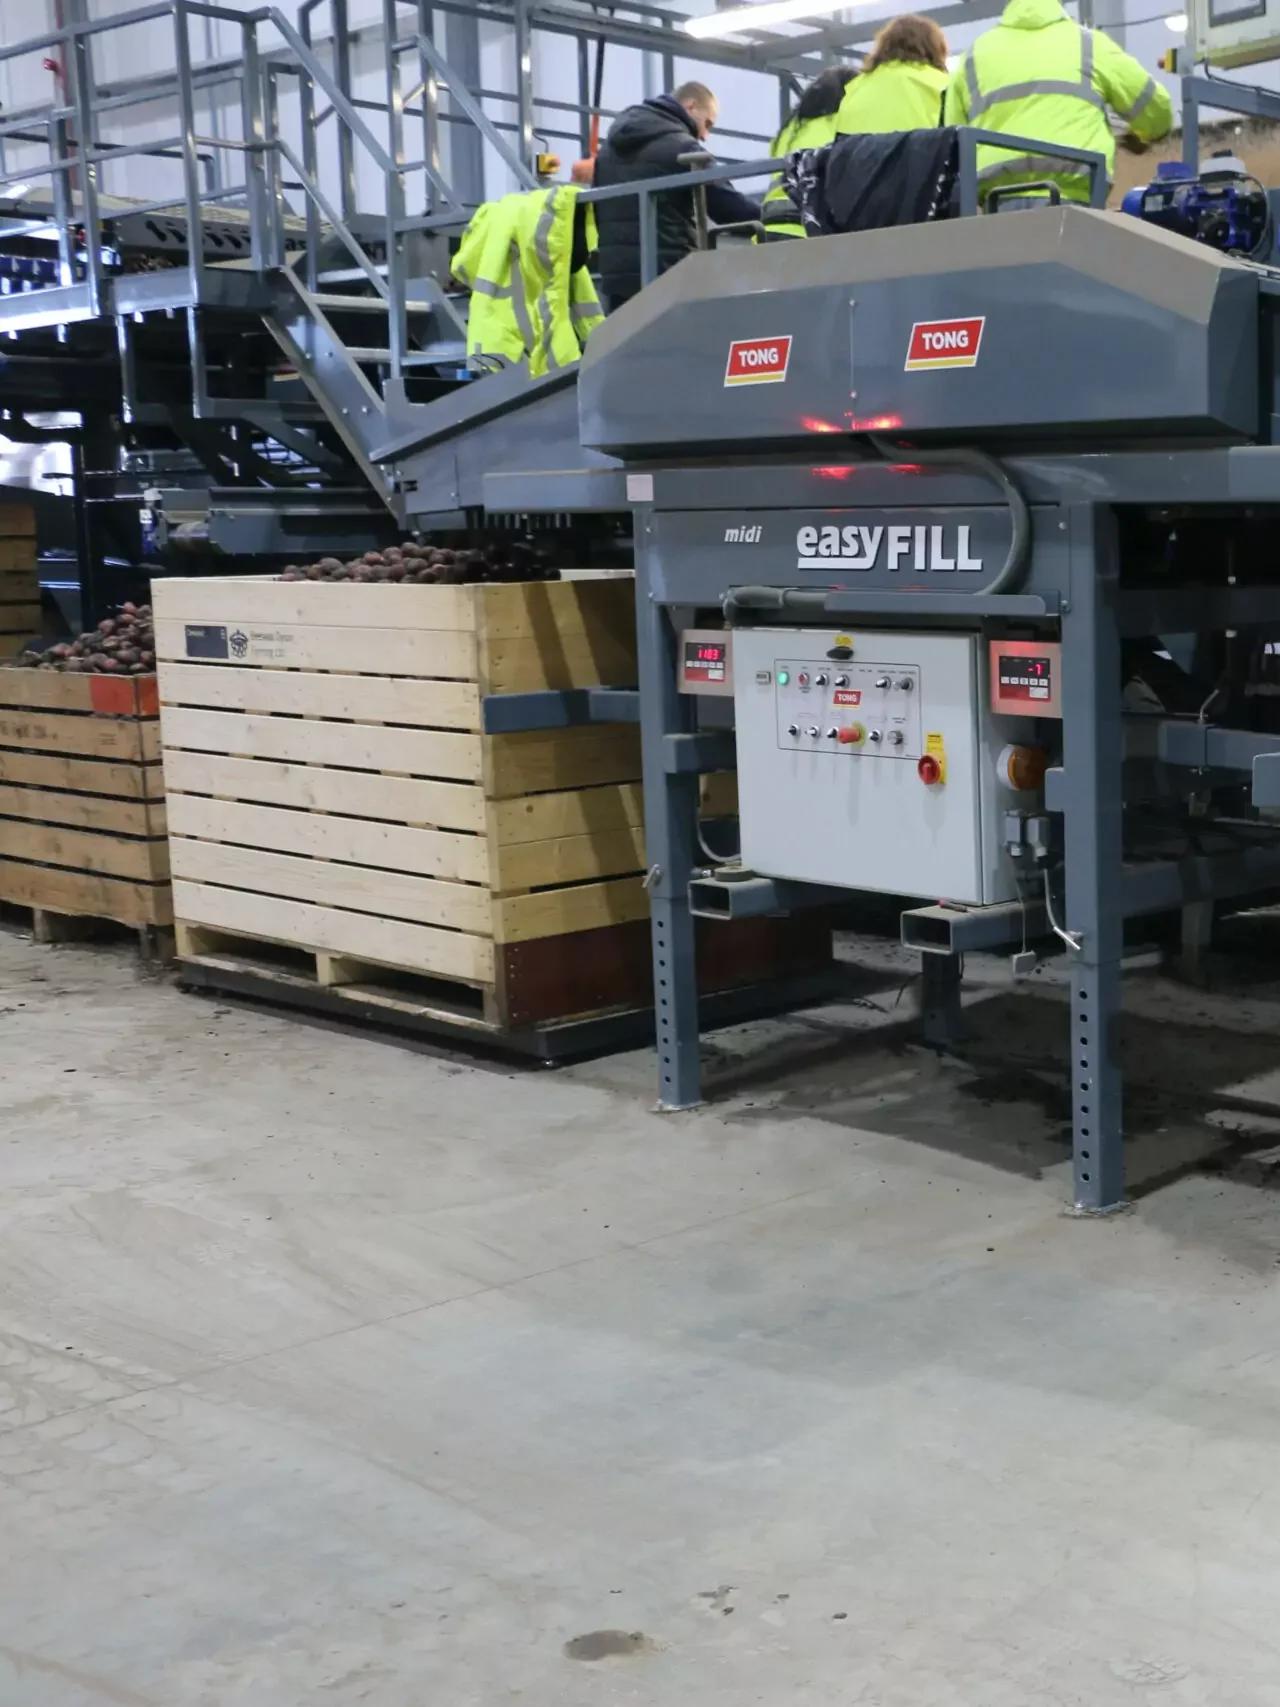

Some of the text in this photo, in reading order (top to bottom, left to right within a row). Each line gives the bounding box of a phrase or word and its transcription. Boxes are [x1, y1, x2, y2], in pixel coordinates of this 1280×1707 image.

[922, 330, 968, 350] TONG
[738, 348, 778, 367] TONG
[724, 525, 763, 543] midi
[837, 693, 858, 703] TONG
